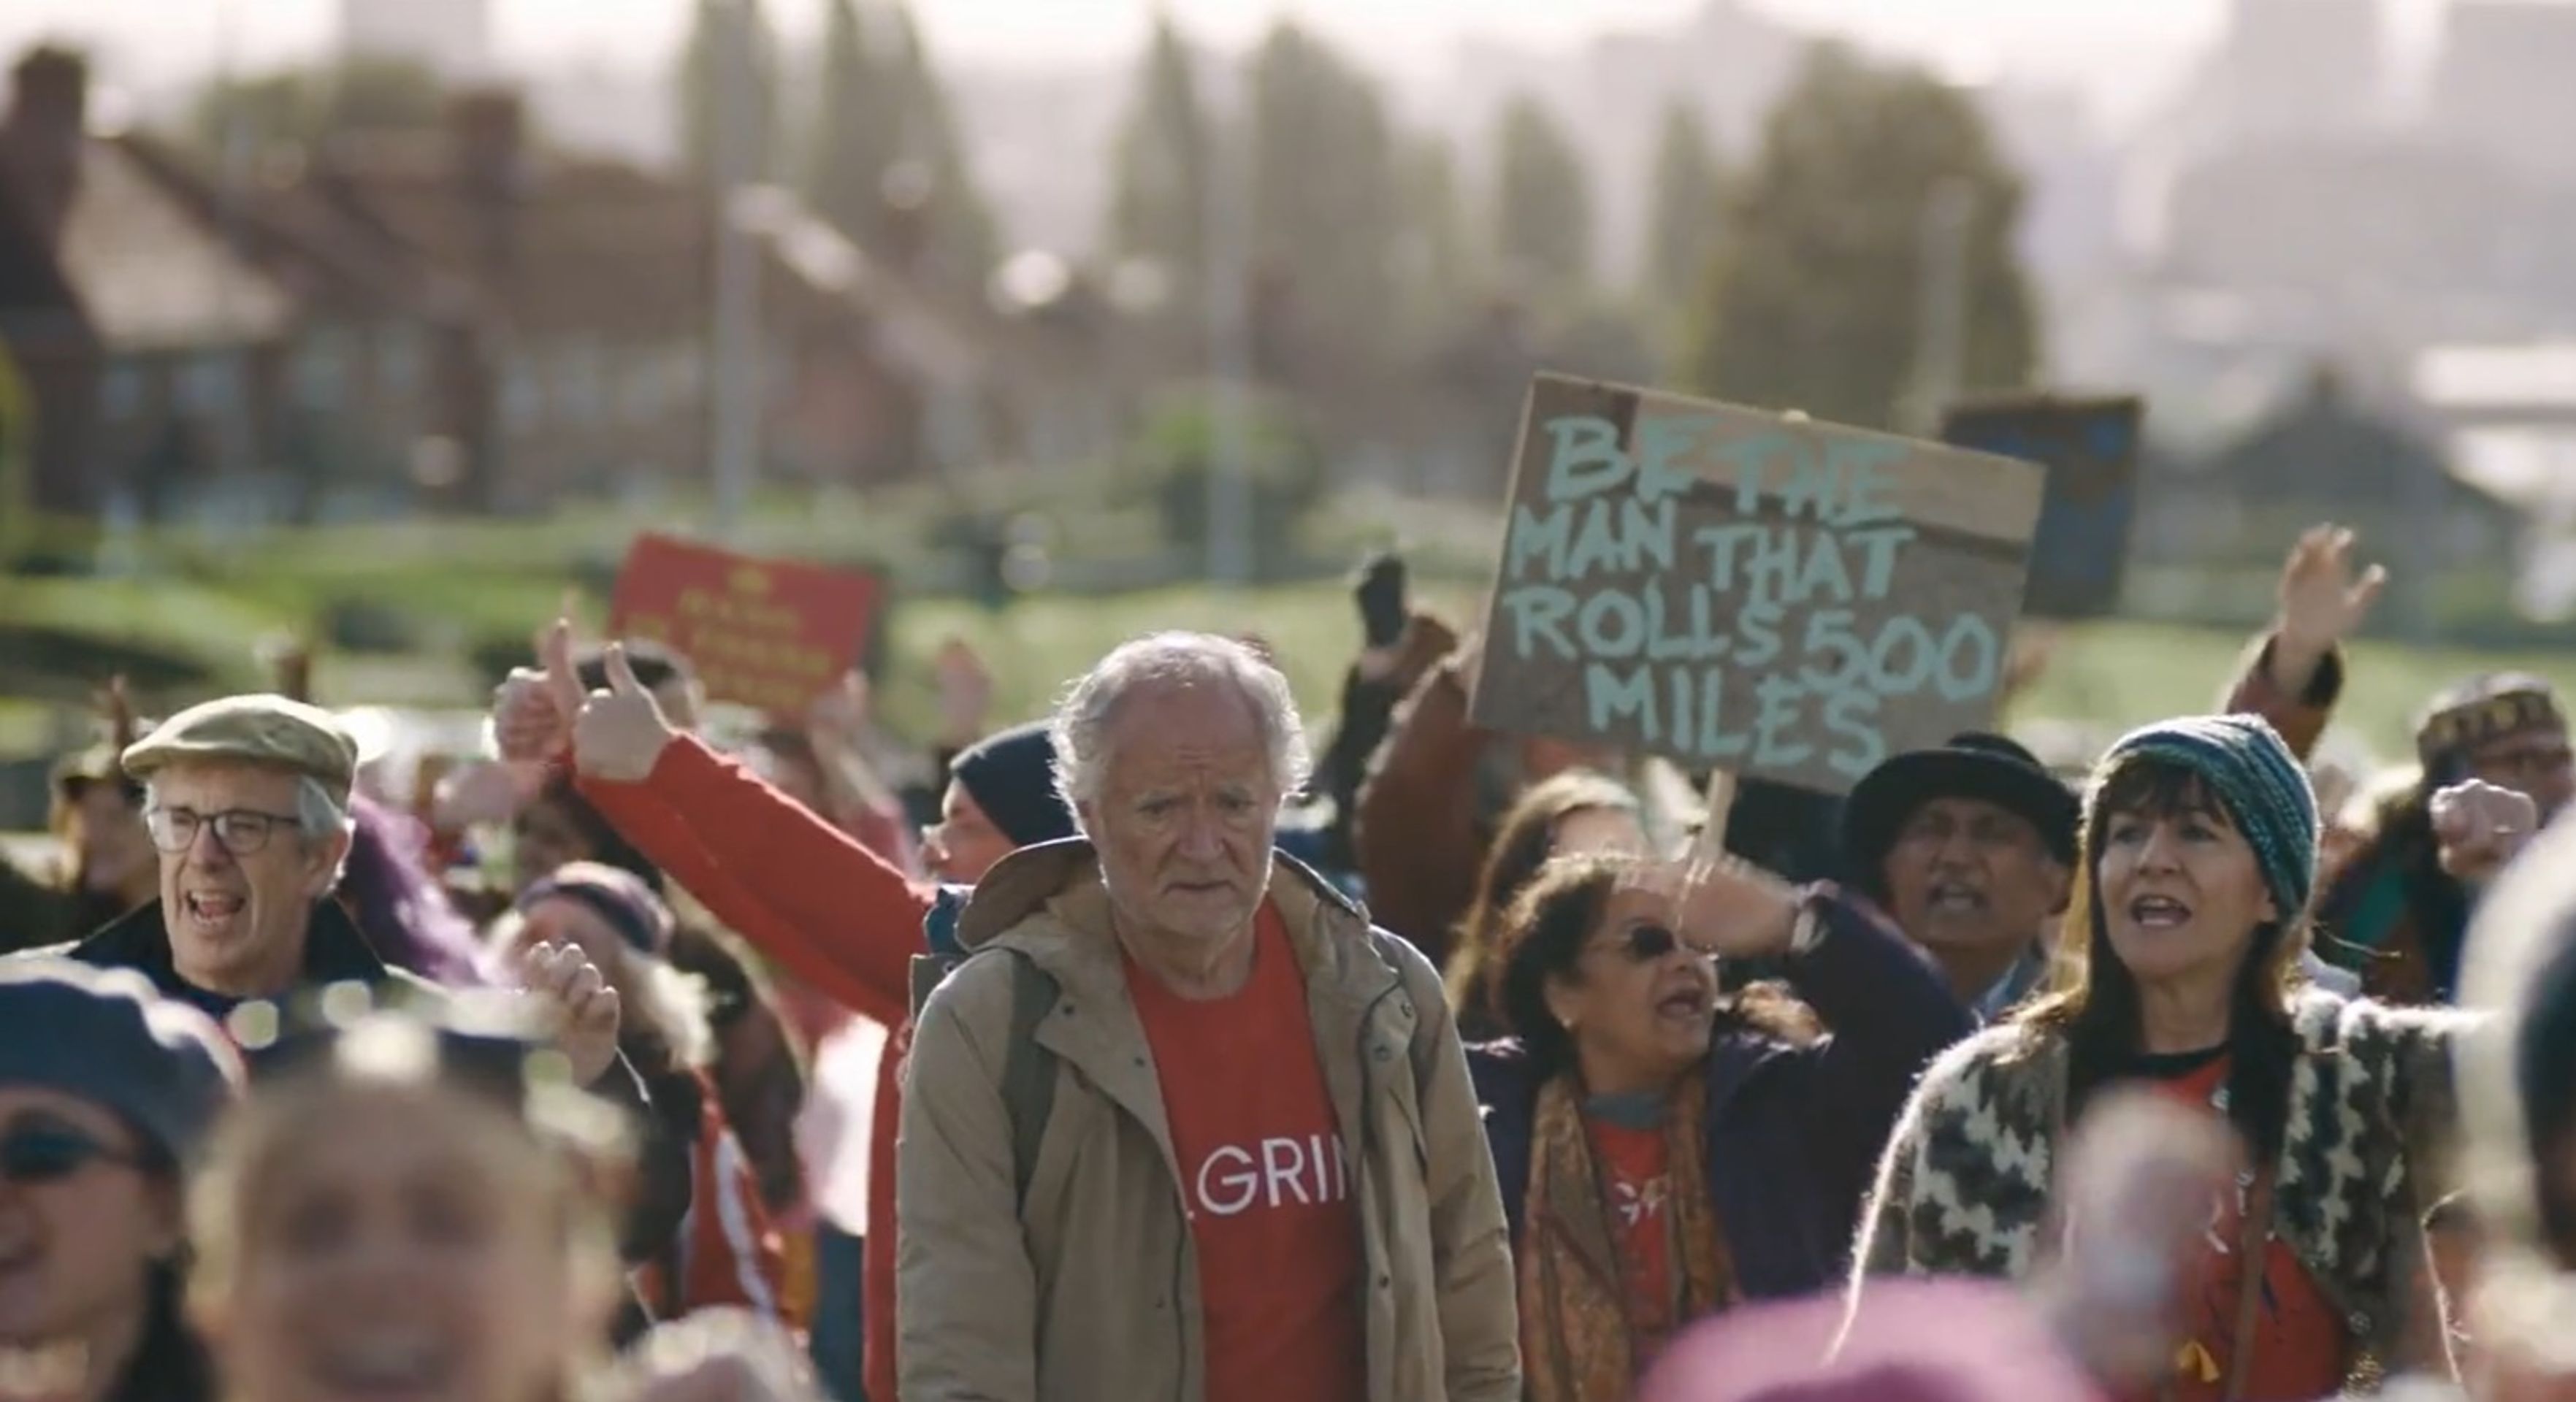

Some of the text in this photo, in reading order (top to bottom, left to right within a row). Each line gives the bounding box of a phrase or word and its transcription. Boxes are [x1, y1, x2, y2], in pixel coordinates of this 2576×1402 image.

[1545, 415, 1908, 526] BE THE
[1508, 499, 1916, 602] MAN THAT
[1503, 575, 1996, 700] ROLLS 500
[1586, 663, 1884, 775] MILES
[1187, 1133, 1348, 1220] GRI
